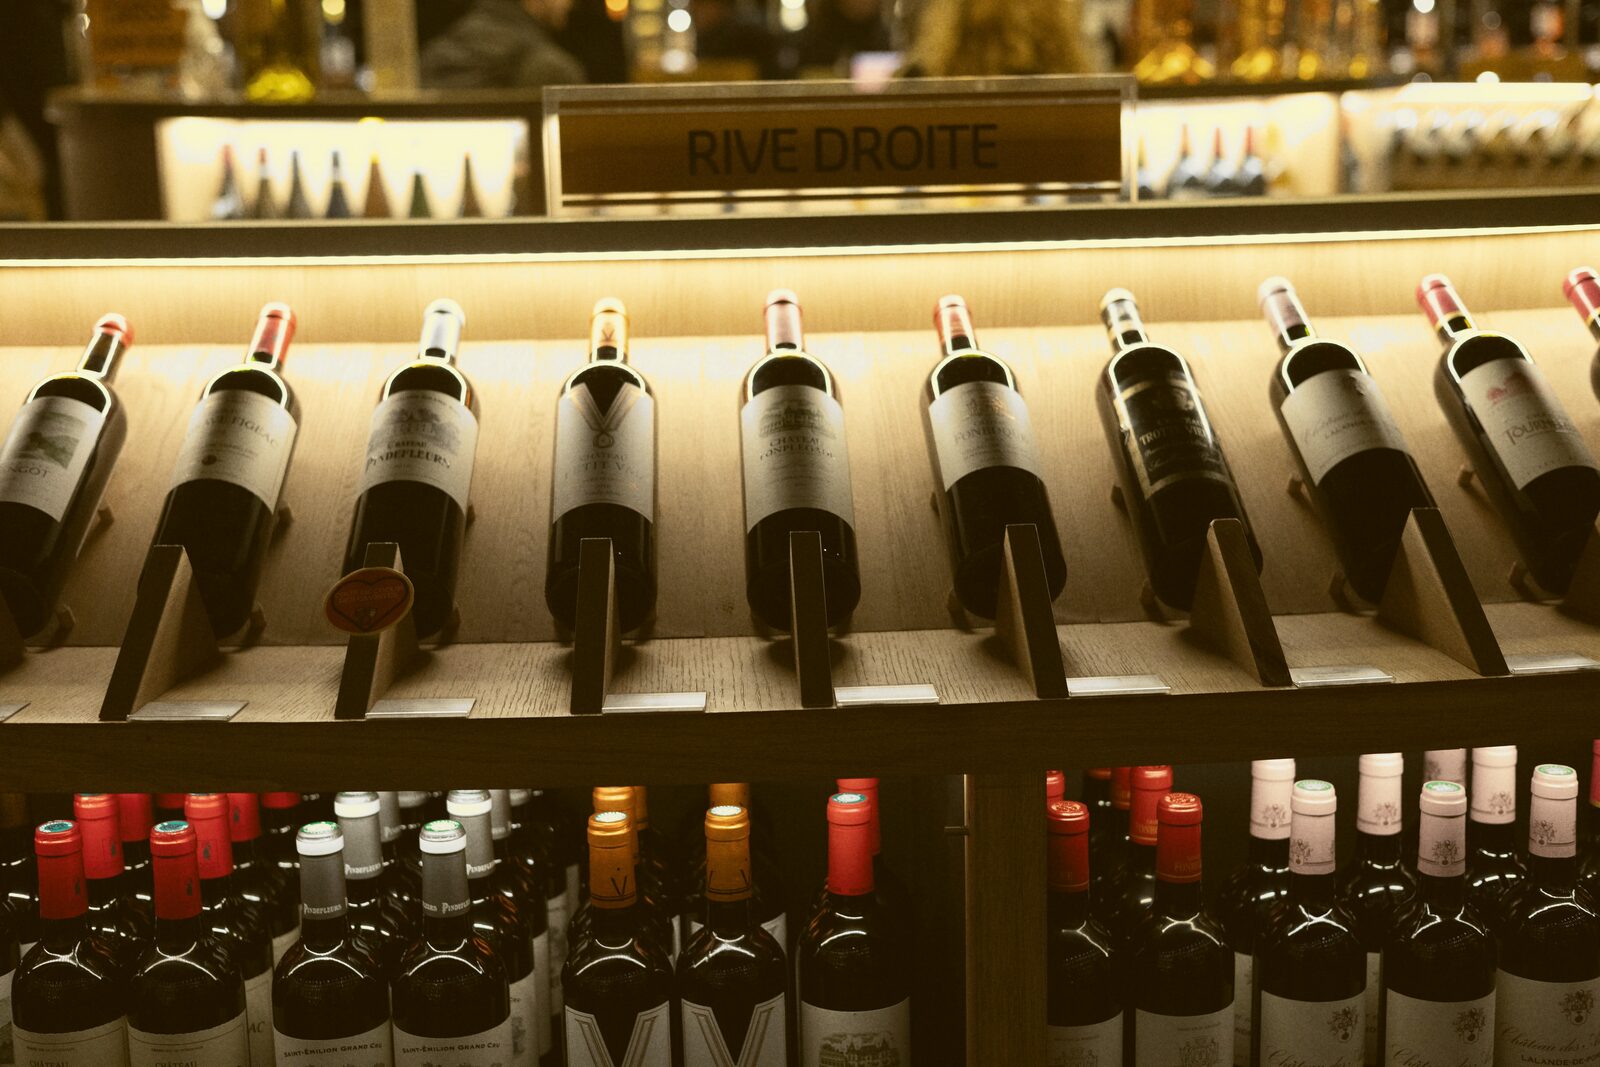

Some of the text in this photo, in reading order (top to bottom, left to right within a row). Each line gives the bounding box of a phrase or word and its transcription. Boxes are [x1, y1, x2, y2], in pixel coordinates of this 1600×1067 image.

[687, 122, 998, 177] RIVE DROITE
[340, 1044, 368, 1052] GRAND
[457, 1043, 486, 1051] GRAND
